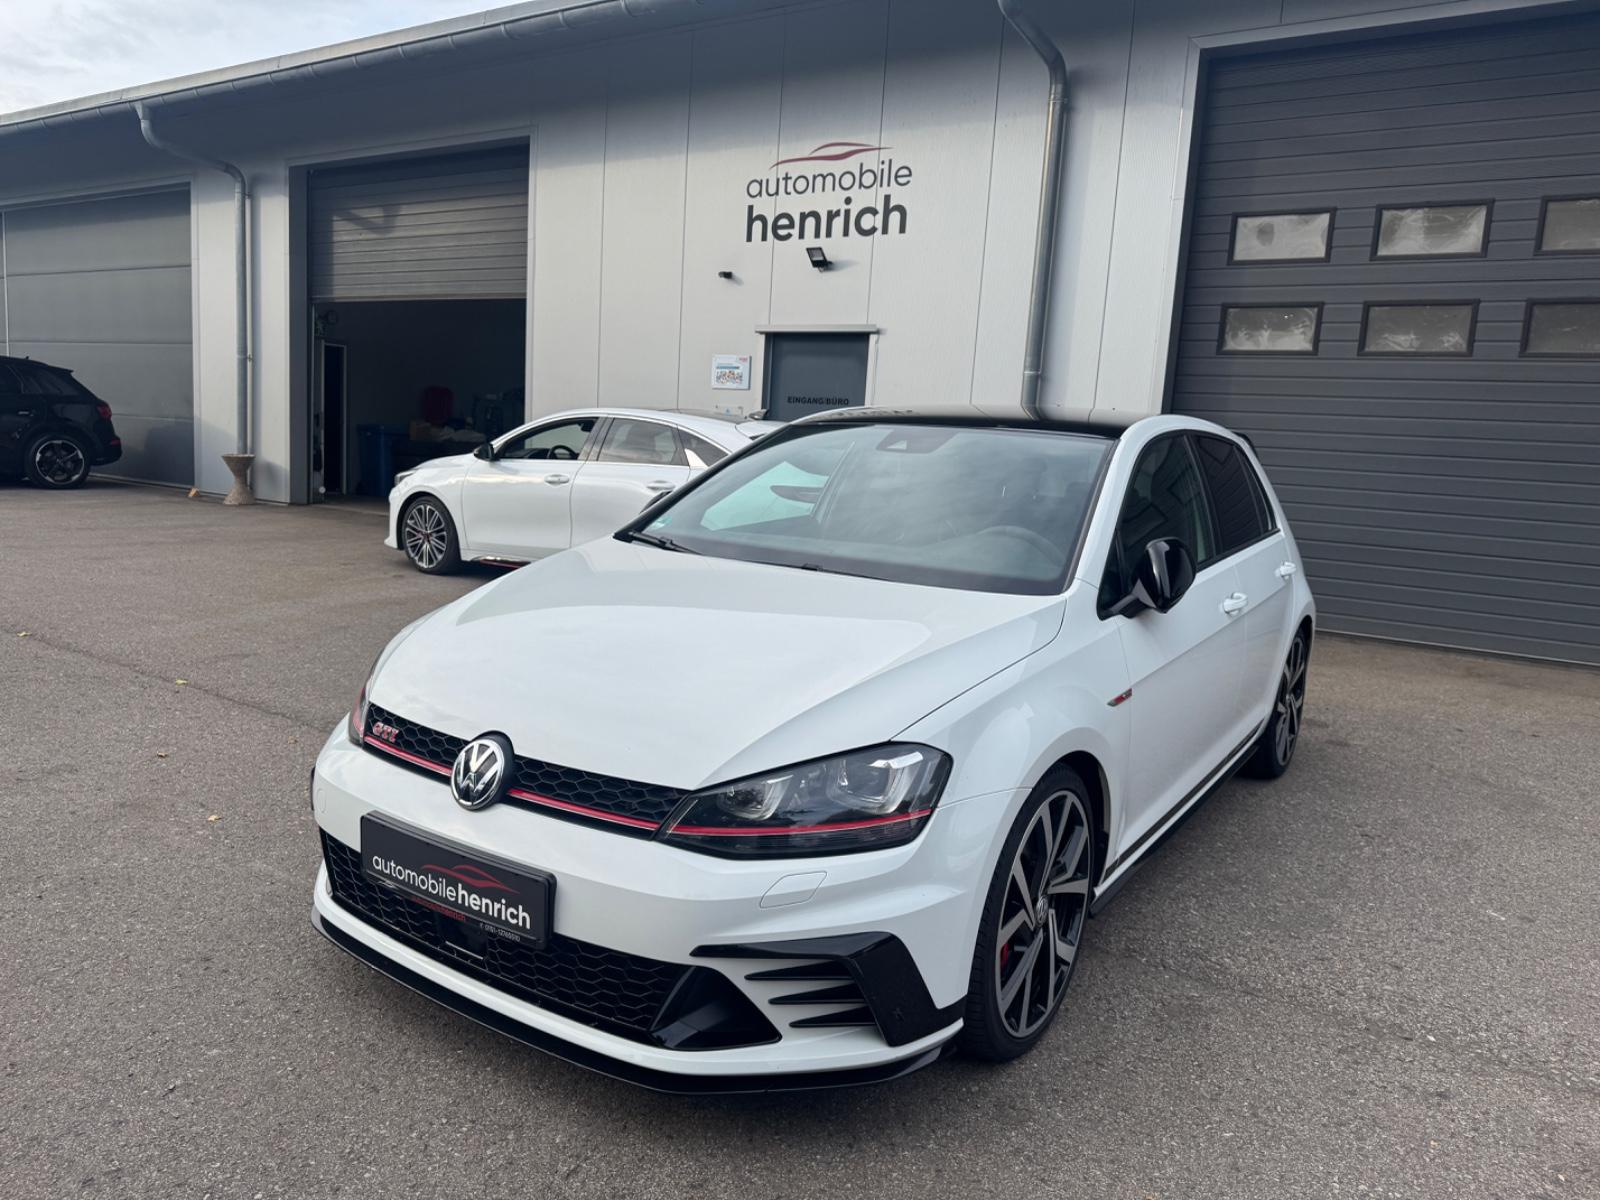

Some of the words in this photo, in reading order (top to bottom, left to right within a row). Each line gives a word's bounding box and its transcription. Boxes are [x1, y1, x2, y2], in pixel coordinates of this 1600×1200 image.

[746, 158, 913, 198] automobile
[746, 194, 908, 242] henrich
[373, 721, 399, 743] GTI
